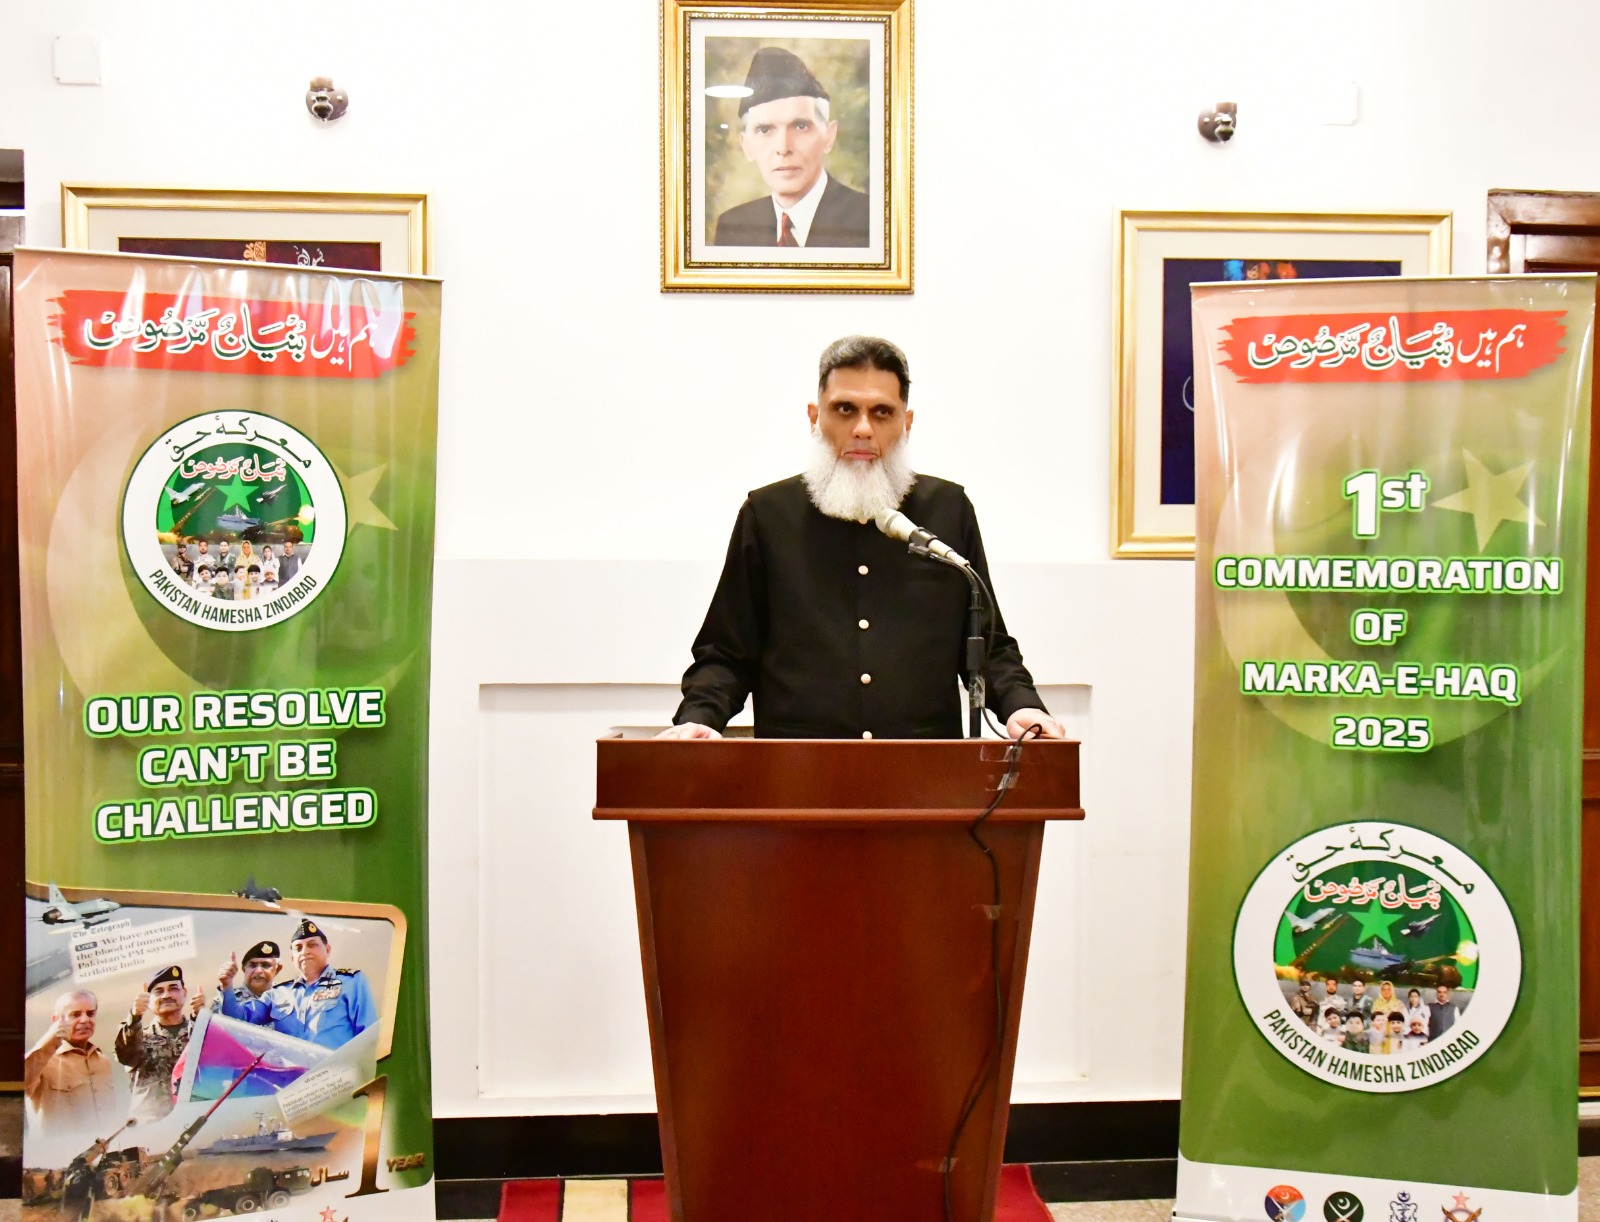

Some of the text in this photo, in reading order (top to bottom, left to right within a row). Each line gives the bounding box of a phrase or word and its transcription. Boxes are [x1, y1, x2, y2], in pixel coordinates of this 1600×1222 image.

[1345, 472, 1428, 537] 1st
[1215, 557, 1561, 591] COMMEMORATION
[149, 569, 317, 624] PAKISTAN HAMESHA ZINDABAD
[1354, 611, 1405, 642] OF
[1242, 662, 1519, 702] MARKA-E-HAQ
[86, 690, 382, 735] OUR RESOLVE
[1333, 716, 1430, 748] 2025
[278, 741, 334, 778] BE
[95, 791, 374, 841] CHALLENGED
[72, 920, 130, 939] The Telegraph
[120, 930, 141, 941] have
[144, 921, 184, 937] avenged
[76, 952, 93, 961] the
[95, 944, 122, 957] blood
[125, 942, 134, 951] of
[128, 949, 144, 959] PM
[147, 944, 165, 954] says
[168, 939, 191, 950] after
[79, 958, 145, 979] striking India
[1263, 1008, 1480, 1083] PAKISTAN HAMESHA ZINDABAD
[344, 1074, 389, 1198] 1
[386, 1153, 424, 1173] YEAR
[310, 1165, 349, 1187] سال
